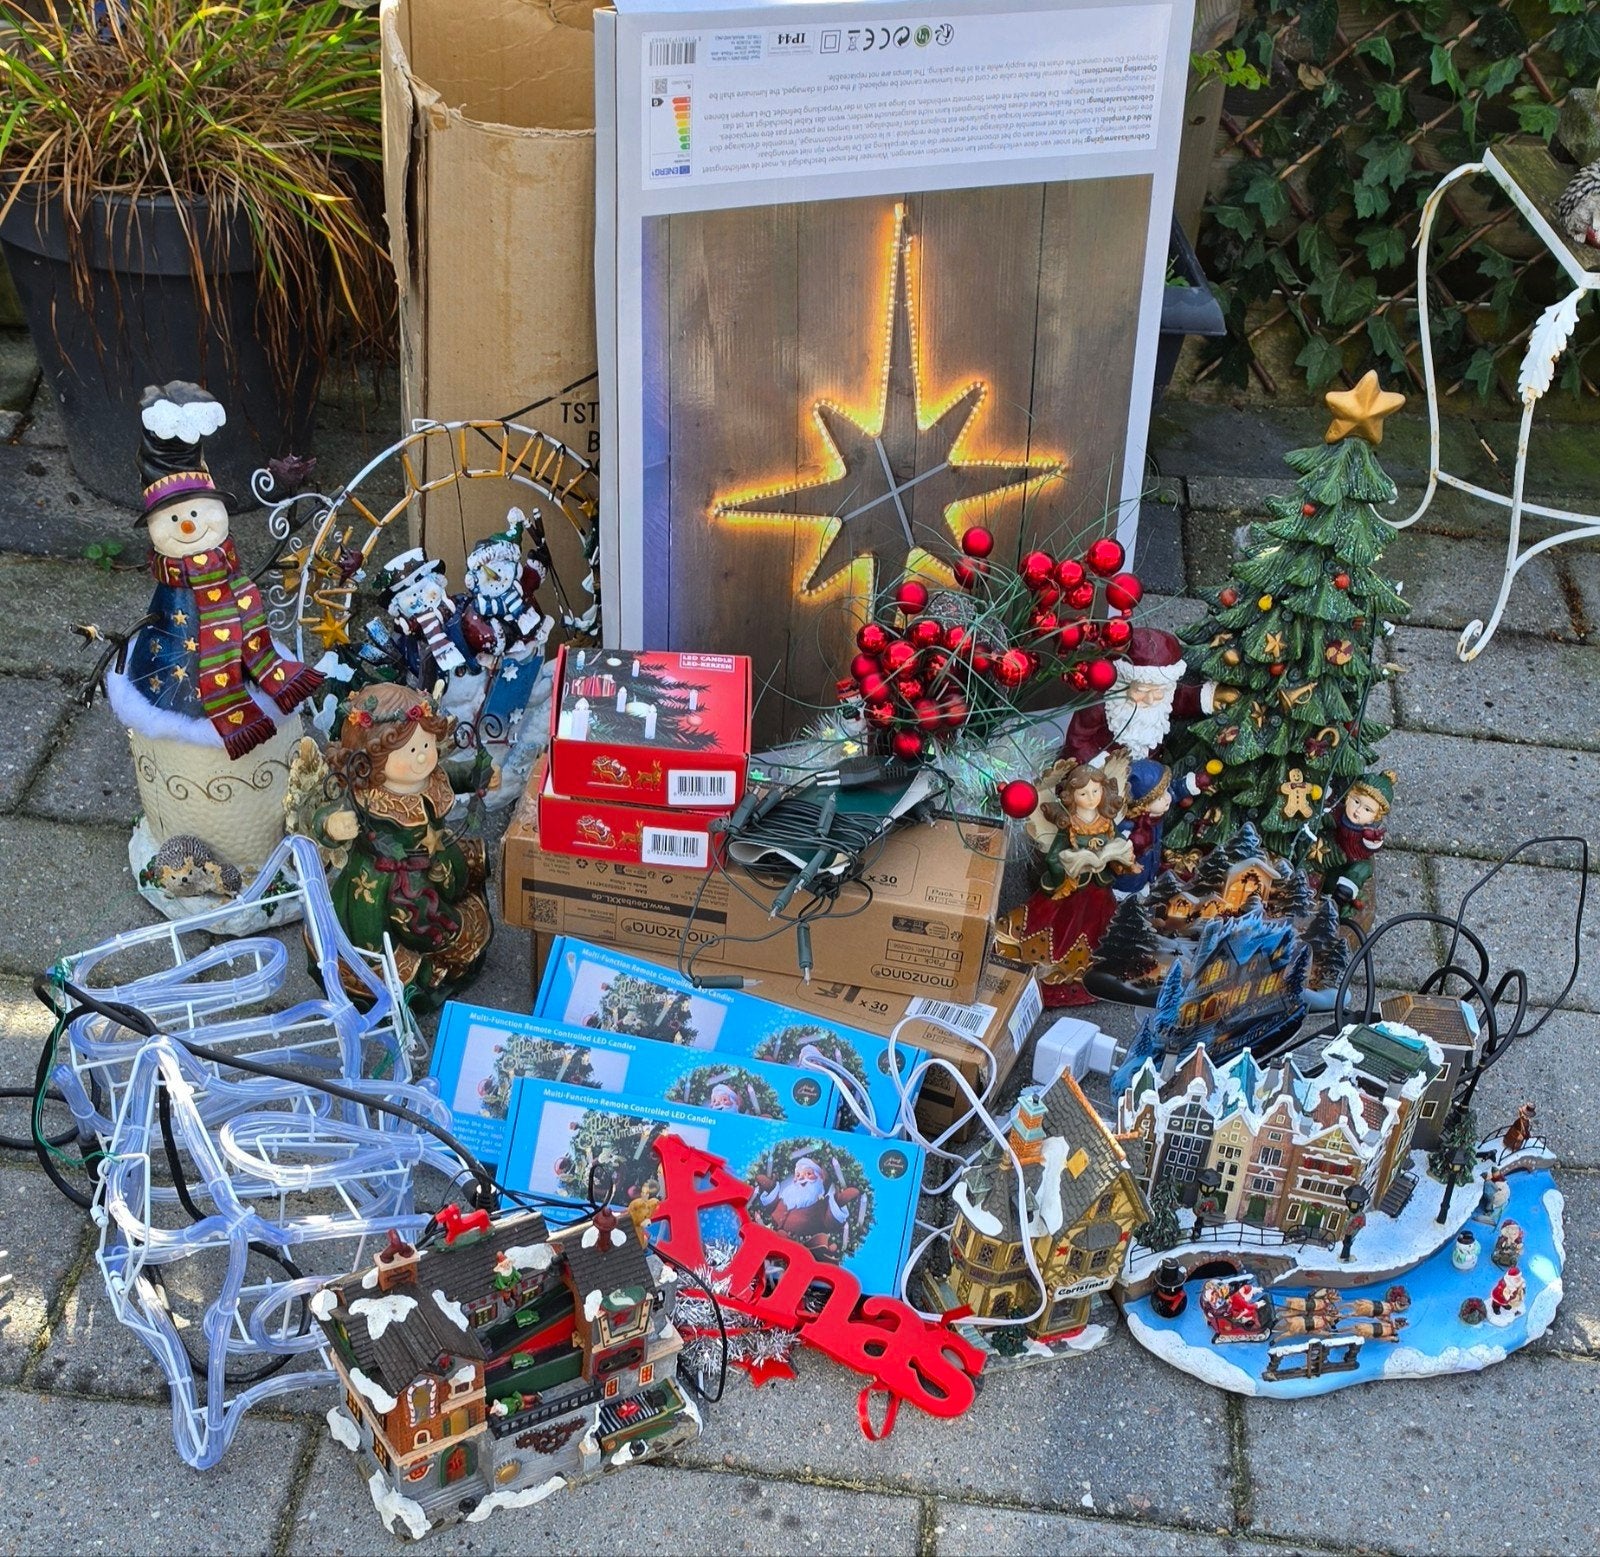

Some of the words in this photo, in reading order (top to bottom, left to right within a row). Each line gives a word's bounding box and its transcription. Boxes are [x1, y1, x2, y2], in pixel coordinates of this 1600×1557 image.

[777, 32, 805, 44] IP44
[560, 402, 599, 423] TST
[682, 660, 731, 668] LED-KERZEN
[880, 874, 898, 884] 30
[932, 889, 953, 898] Pack
[591, 893, 671, 911] www.DeubaXXL.de
[923, 959, 945, 968] Pack
[581, 948, 631, 969] Multi-Function
[631, 964, 657, 977] Remote
[707, 989, 735, 1003] Candles
[880, 966, 955, 988] monzana
[871, 1001, 889, 1012] 30
[469, 1012, 523, 1029] Multi-Function
[524, 1022, 552, 1034] Remote
[553, 1029, 591, 1042] Controlled
[592, 1036, 607, 1045] LED
[608, 1040, 636, 1051] Candles
[543, 1088, 598, 1105] Multi-Function
[600, 1098, 629, 1109] Remote
[630, 1104, 669, 1117] Controlled
[670, 1111, 685, 1119] LED
[686, 1114, 716, 1125] Candles
